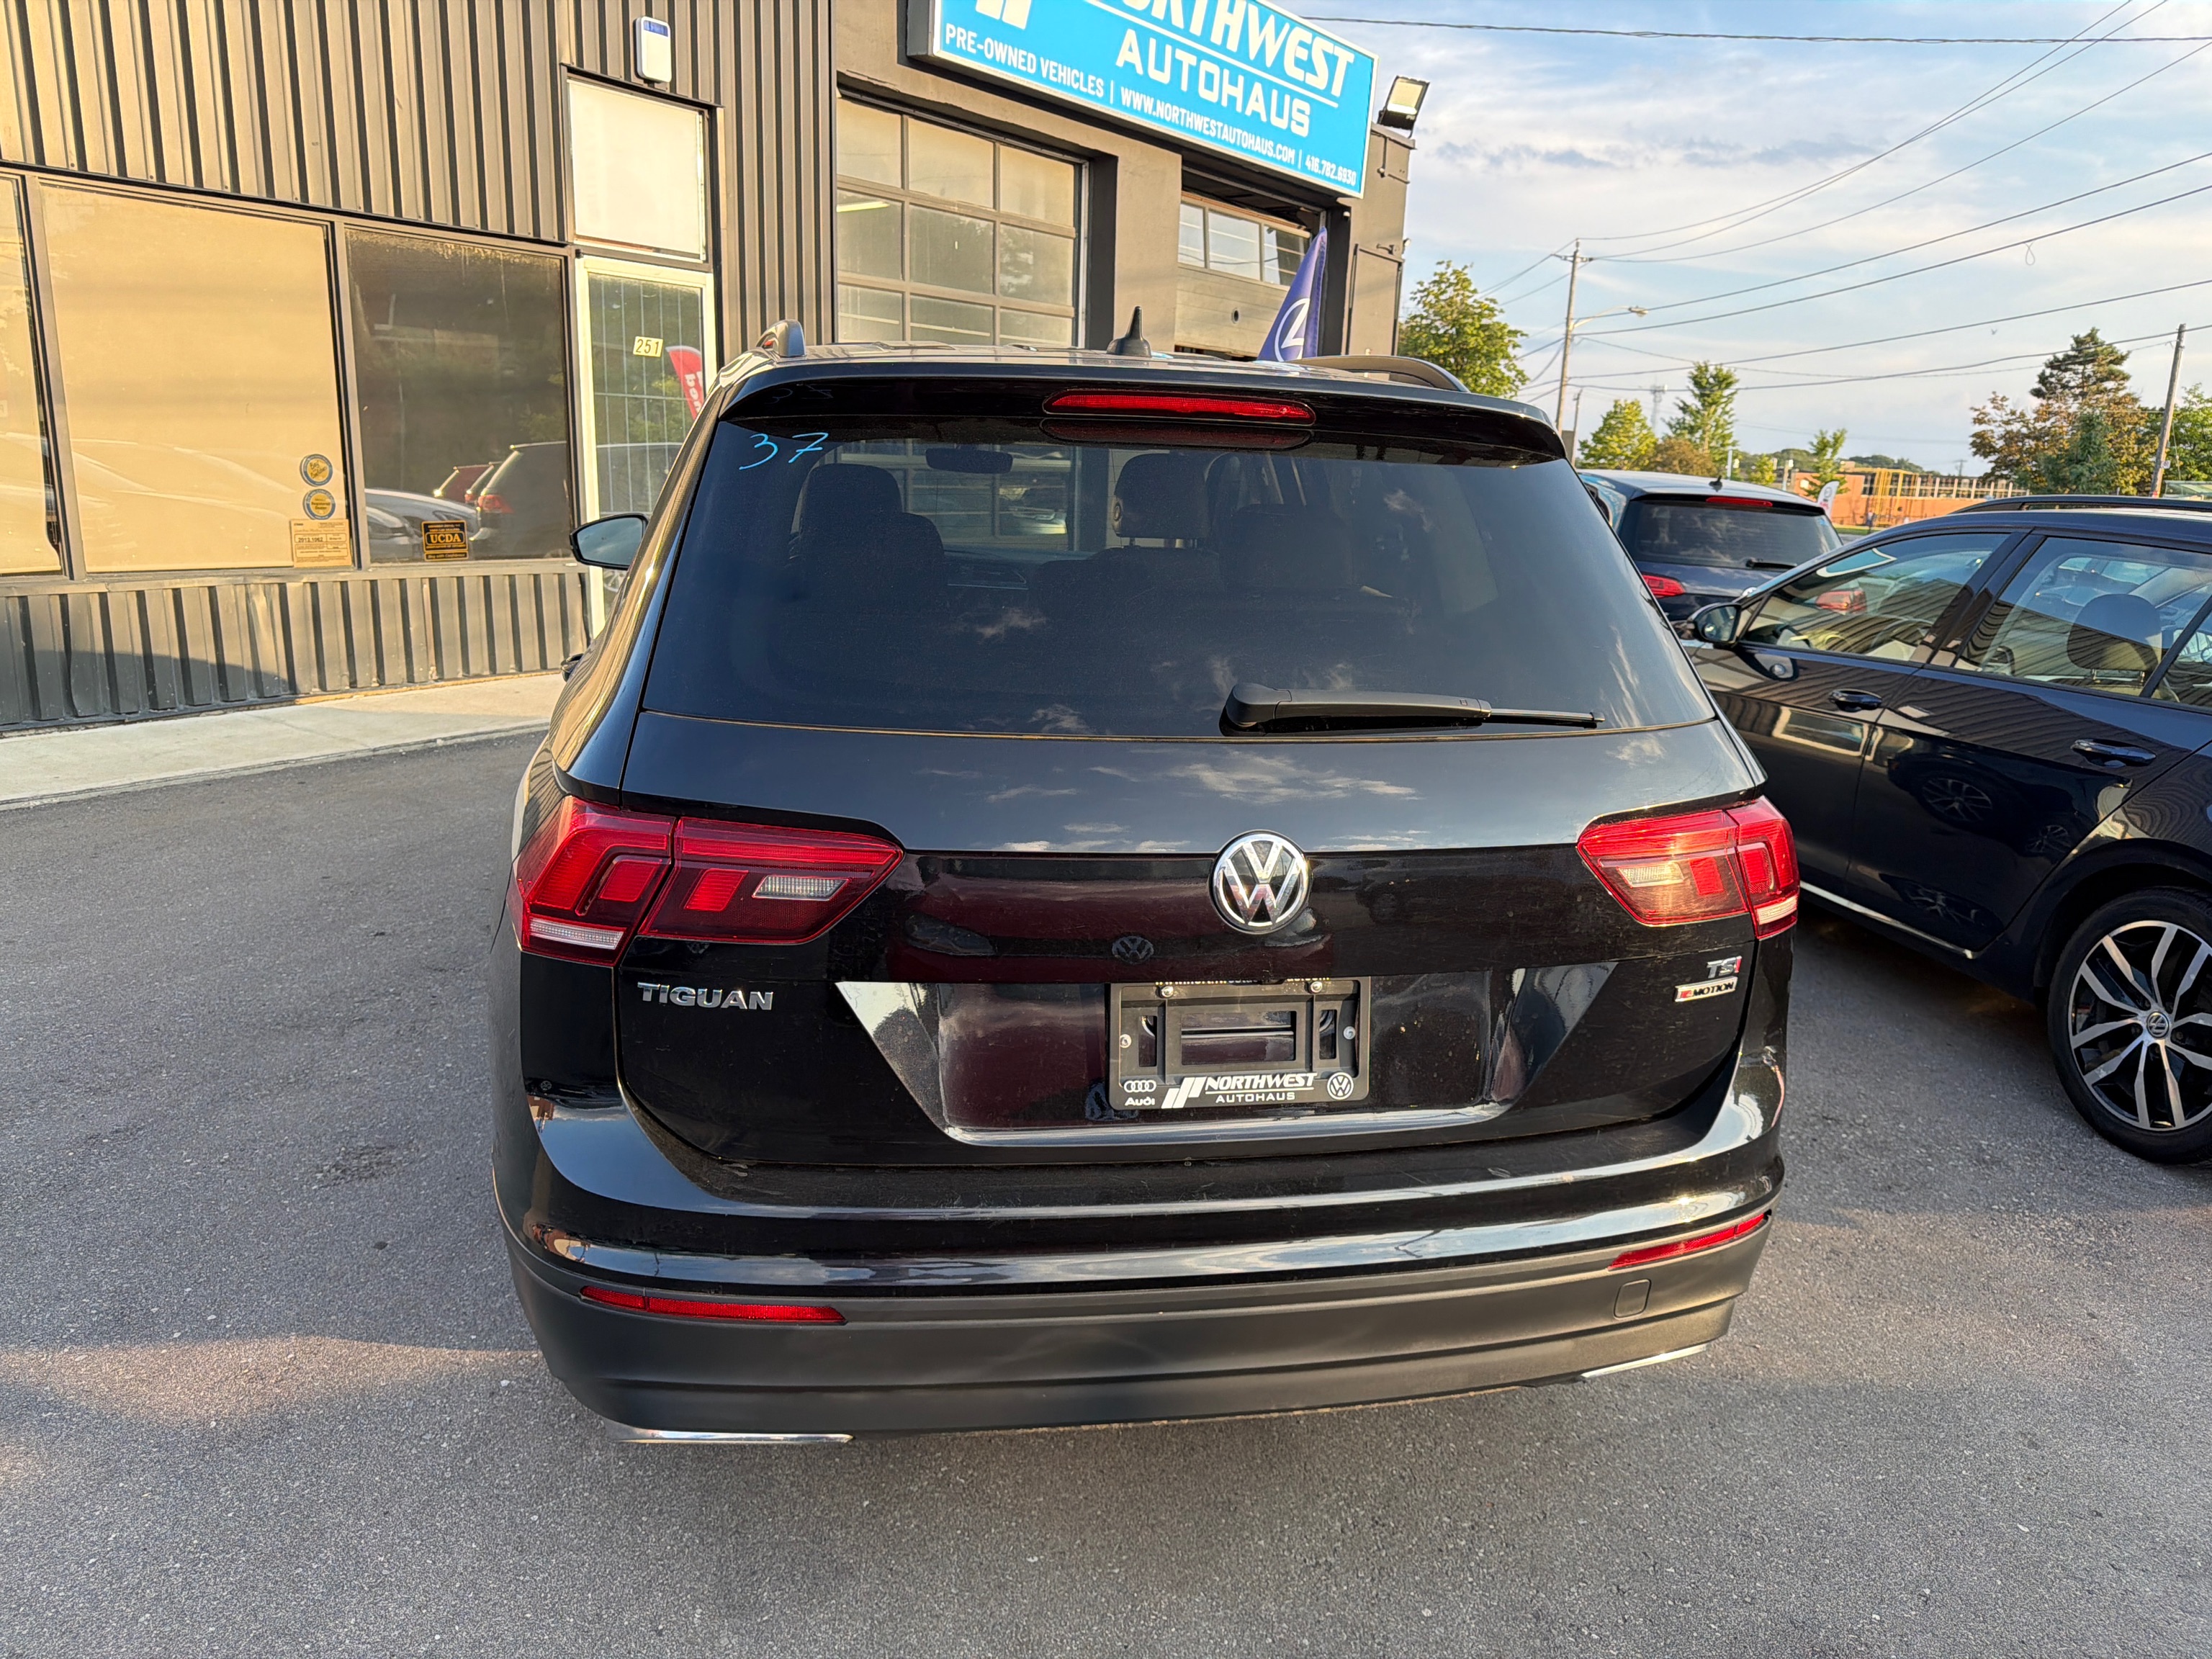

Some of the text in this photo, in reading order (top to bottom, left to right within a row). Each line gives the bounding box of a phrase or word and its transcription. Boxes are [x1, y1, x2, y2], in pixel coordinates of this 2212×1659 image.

[1115, 28, 1311, 138] AUTOHAUS
[945, 23, 1357, 186] PRE-OWNED VEHICLES WWW.NORTHWESTAUTOHAUS.COM 416.782.6930
[635, 338, 661, 355] 251
[739, 432, 829, 470] 37
[430, 534, 462, 544] UCDA
[1707, 956, 1743, 979] TSI
[637, 981, 774, 1011] TIGUAN
[1205, 1072, 1317, 1090] NORTHWEST
[1125, 1097, 1155, 1106] Audi
[1215, 1092, 1295, 1103] AUTOHAUS
